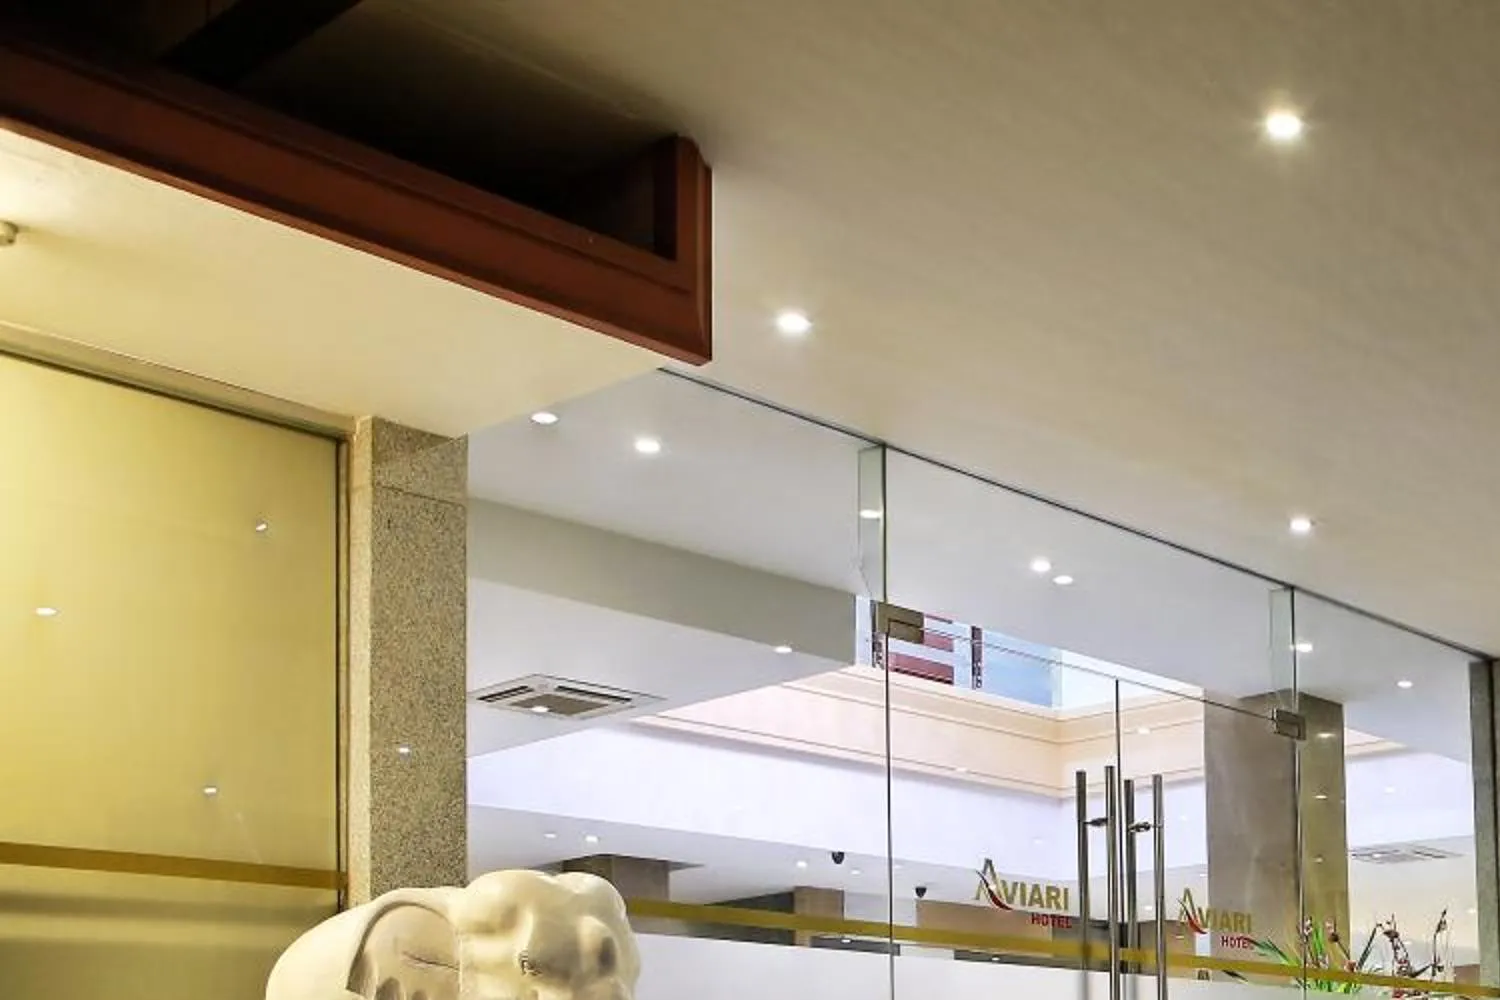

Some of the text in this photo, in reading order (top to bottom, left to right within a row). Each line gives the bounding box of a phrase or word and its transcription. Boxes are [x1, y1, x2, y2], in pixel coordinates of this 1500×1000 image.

[975, 857, 1069, 911] AVIARI
[1031, 911, 1073, 929] HOTEL
[1177, 887, 1251, 934] AVIARI
